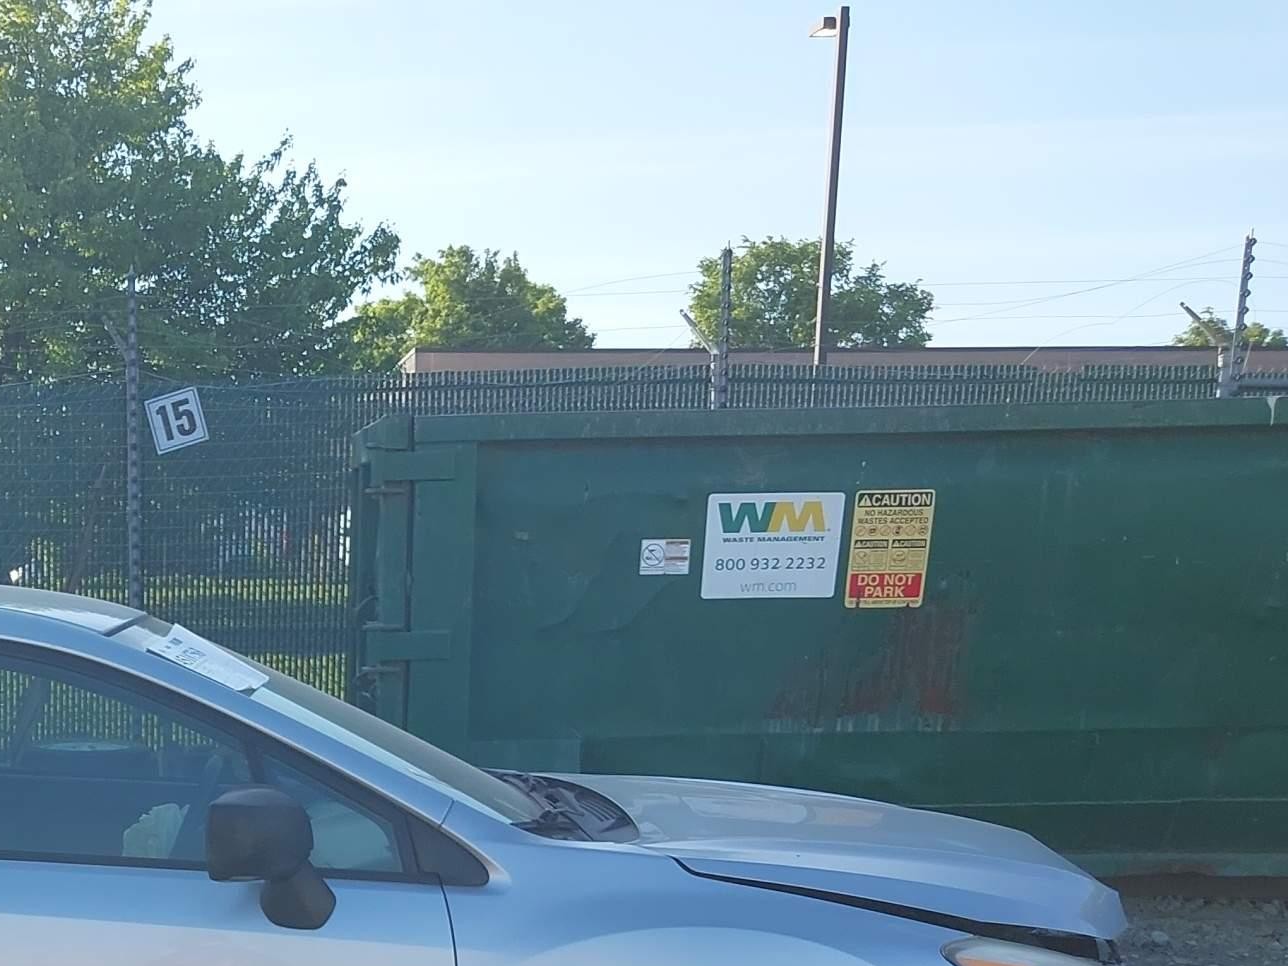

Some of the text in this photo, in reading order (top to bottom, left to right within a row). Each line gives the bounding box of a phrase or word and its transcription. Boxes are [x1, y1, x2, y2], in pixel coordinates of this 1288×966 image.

[155, 398, 197, 441] 15
[872, 494, 931, 506] CAUTION
[718, 501, 826, 533] WM
[715, 557, 826, 571] 800 932 2232
[857, 574, 916, 586] DO NOT
[740, 581, 797, 592] wm.com
[864, 586, 905, 597] PARK
